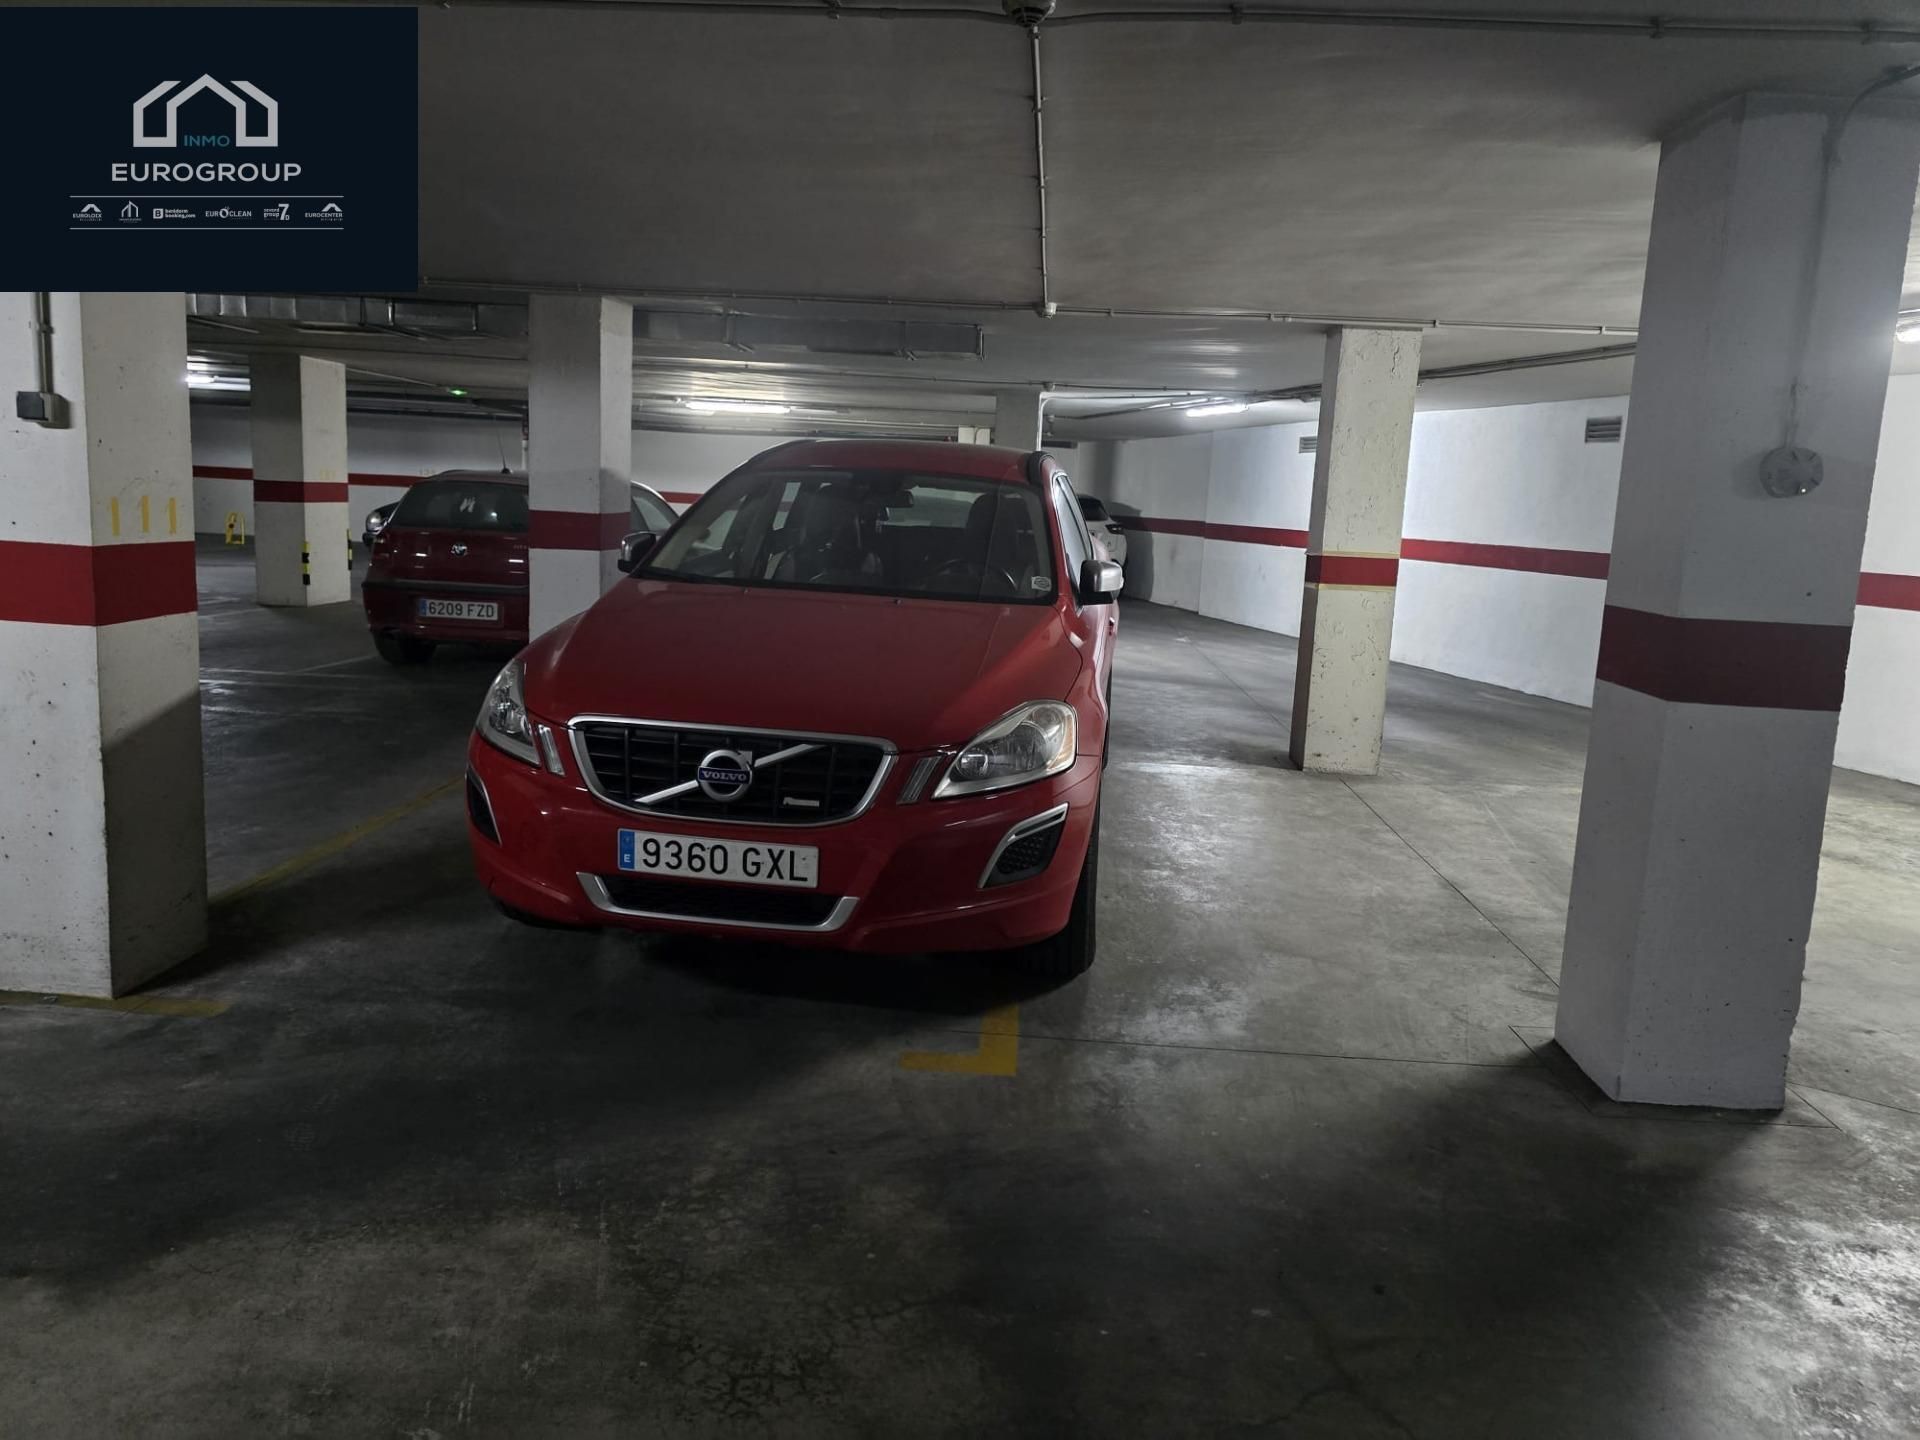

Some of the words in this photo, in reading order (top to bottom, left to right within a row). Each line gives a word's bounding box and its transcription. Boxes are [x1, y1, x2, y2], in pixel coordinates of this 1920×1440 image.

[110, 495, 177, 537] 111
[428, 601, 464, 616] 6209
[467, 603, 495, 618] FZD
[702, 770, 747, 781] VOLVO
[623, 853, 631, 863] E
[642, 838, 729, 874] 9360
[742, 847, 808, 882] GXL
